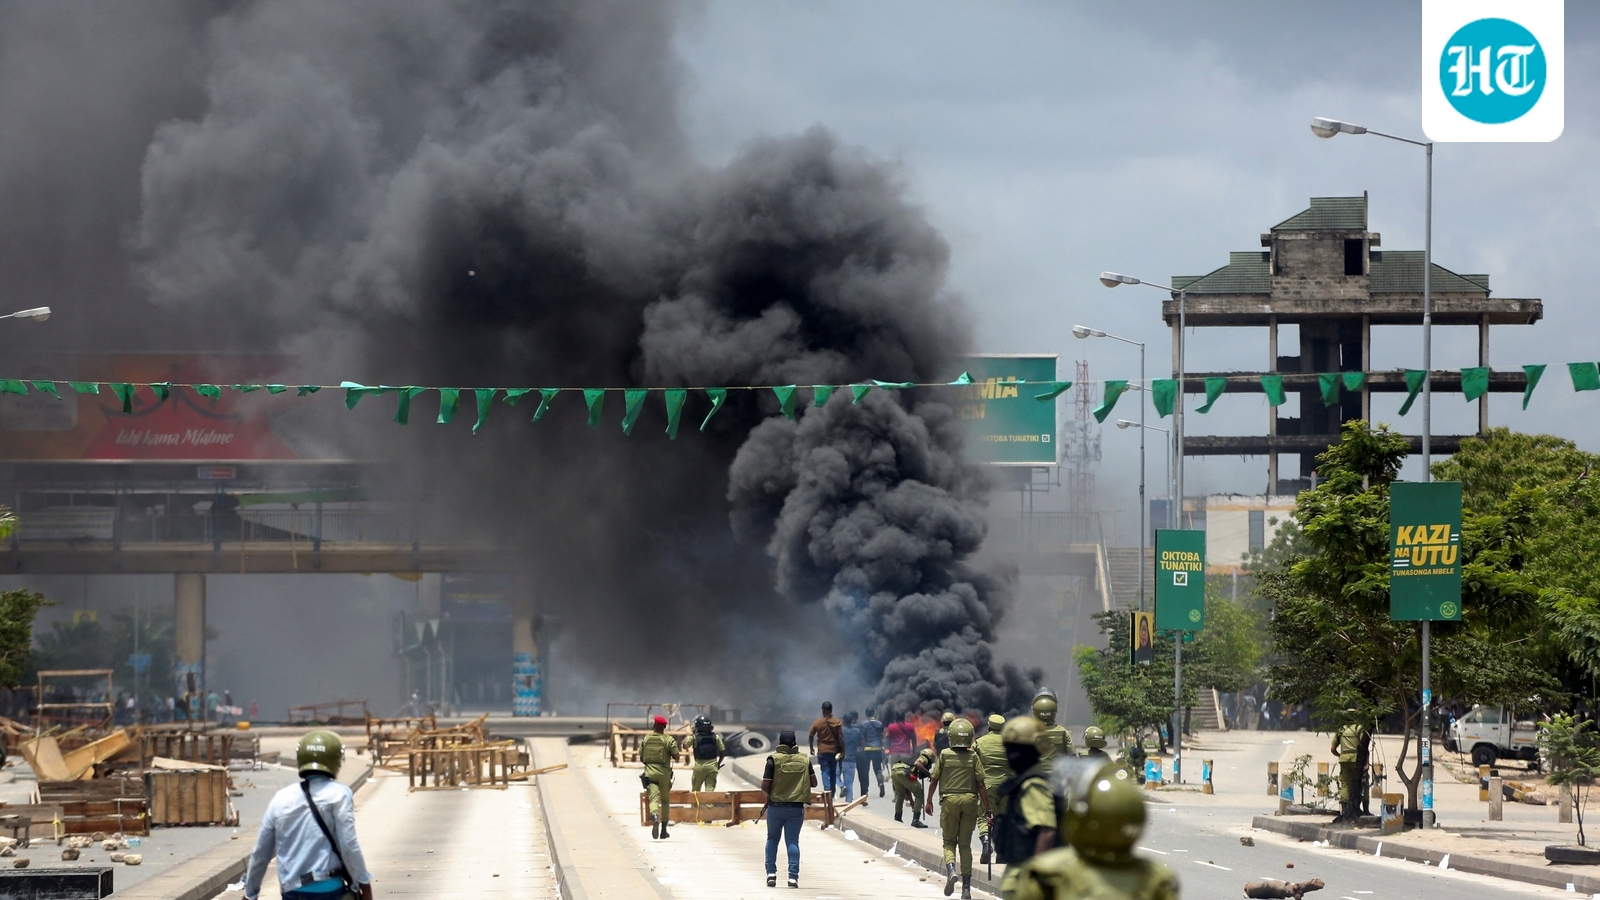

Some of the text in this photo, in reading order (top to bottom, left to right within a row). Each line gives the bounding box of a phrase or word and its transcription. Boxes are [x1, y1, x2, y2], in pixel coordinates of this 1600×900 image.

[142, 429, 180, 446] kama
[1009, 434, 1039, 442] TUNATIKI
[1396, 524, 1451, 545] KAZI
[1162, 551, 1200, 561] OKTOBA
[1394, 545, 1458, 566] NA UTU
[1160, 560, 1202, 571] TUNATIKI
[1393, 568, 1431, 576] TUNASONGA
[306, 744, 326, 752] POLICE
